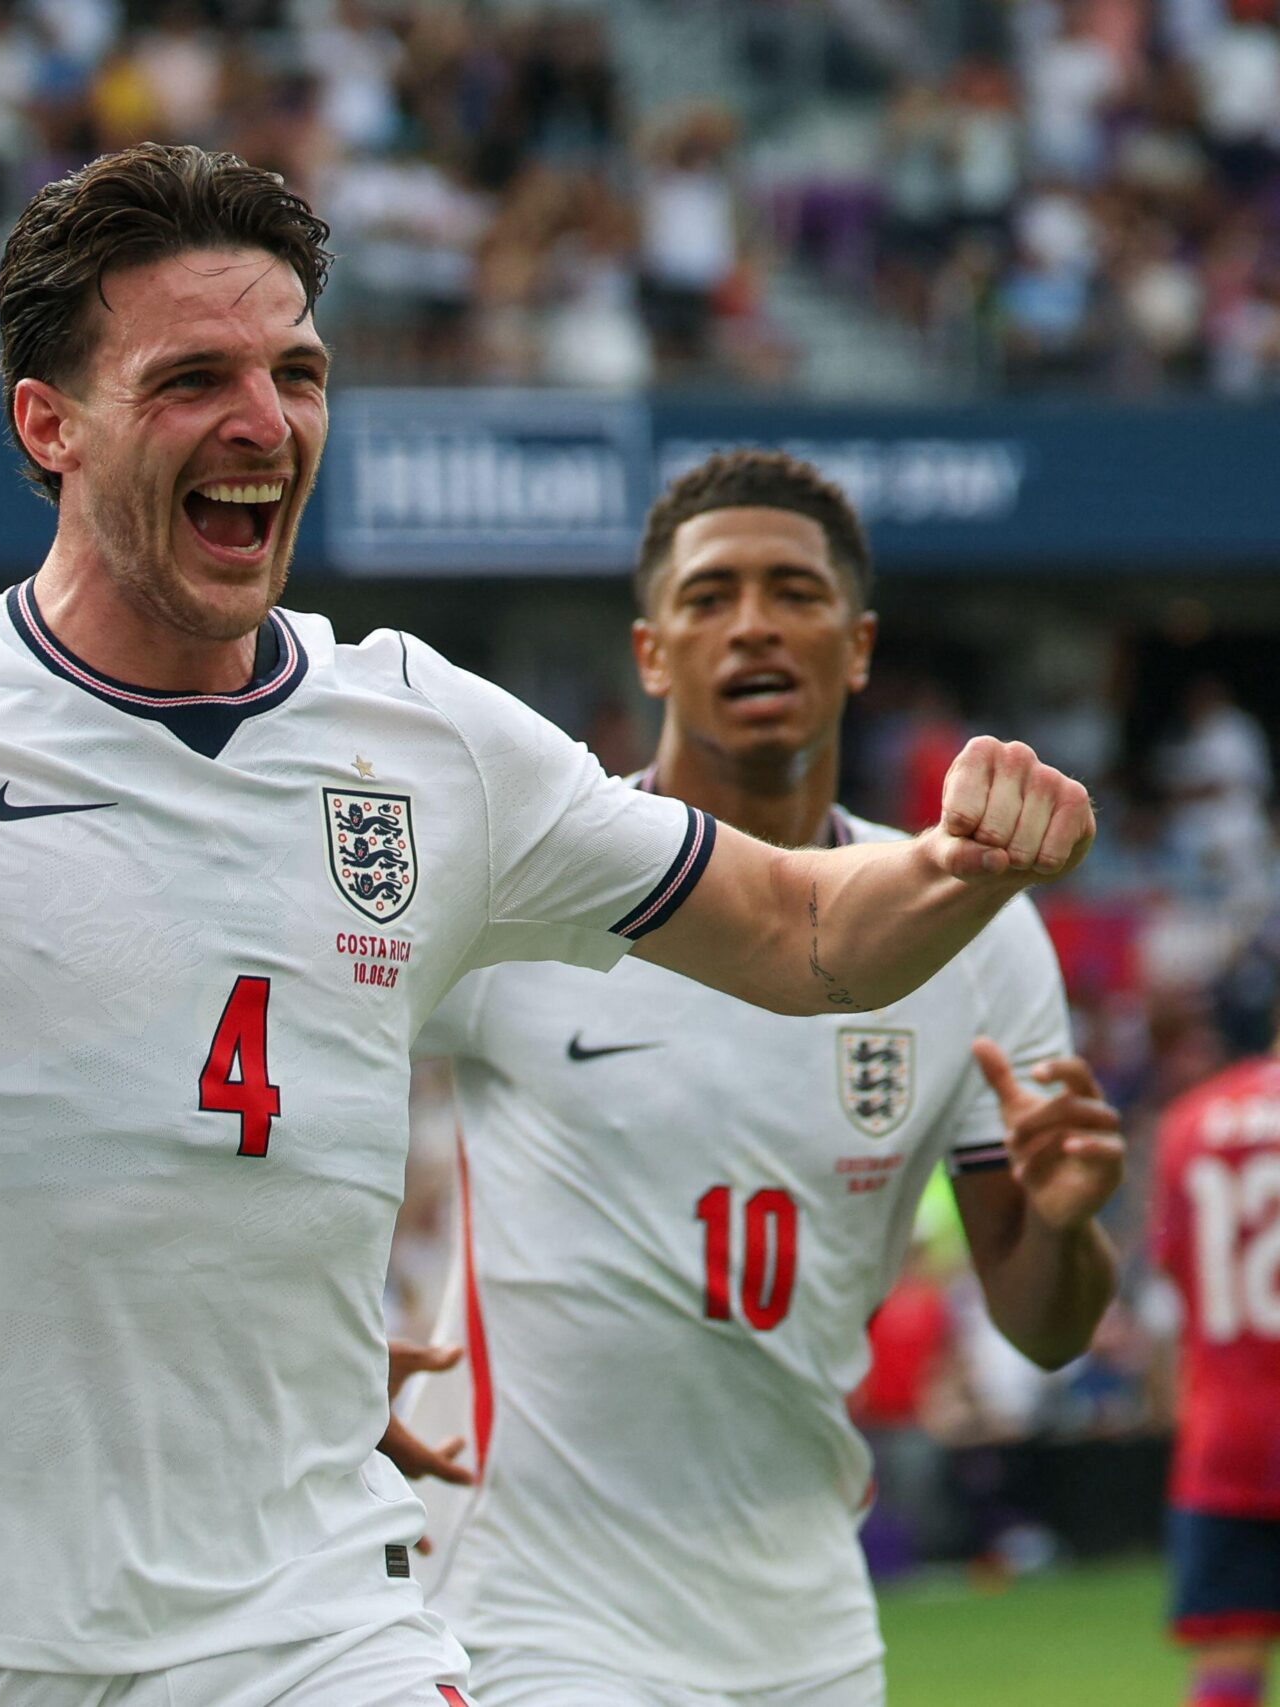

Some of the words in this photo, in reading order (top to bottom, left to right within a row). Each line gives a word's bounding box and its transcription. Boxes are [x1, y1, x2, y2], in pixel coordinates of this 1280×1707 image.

[336, 932, 387, 959] COSTA
[389, 939, 411, 963] RICA
[353, 962, 399, 989] 10.06.26
[198, 974, 281, 1158] 4
[694, 1184, 797, 1331] 10
